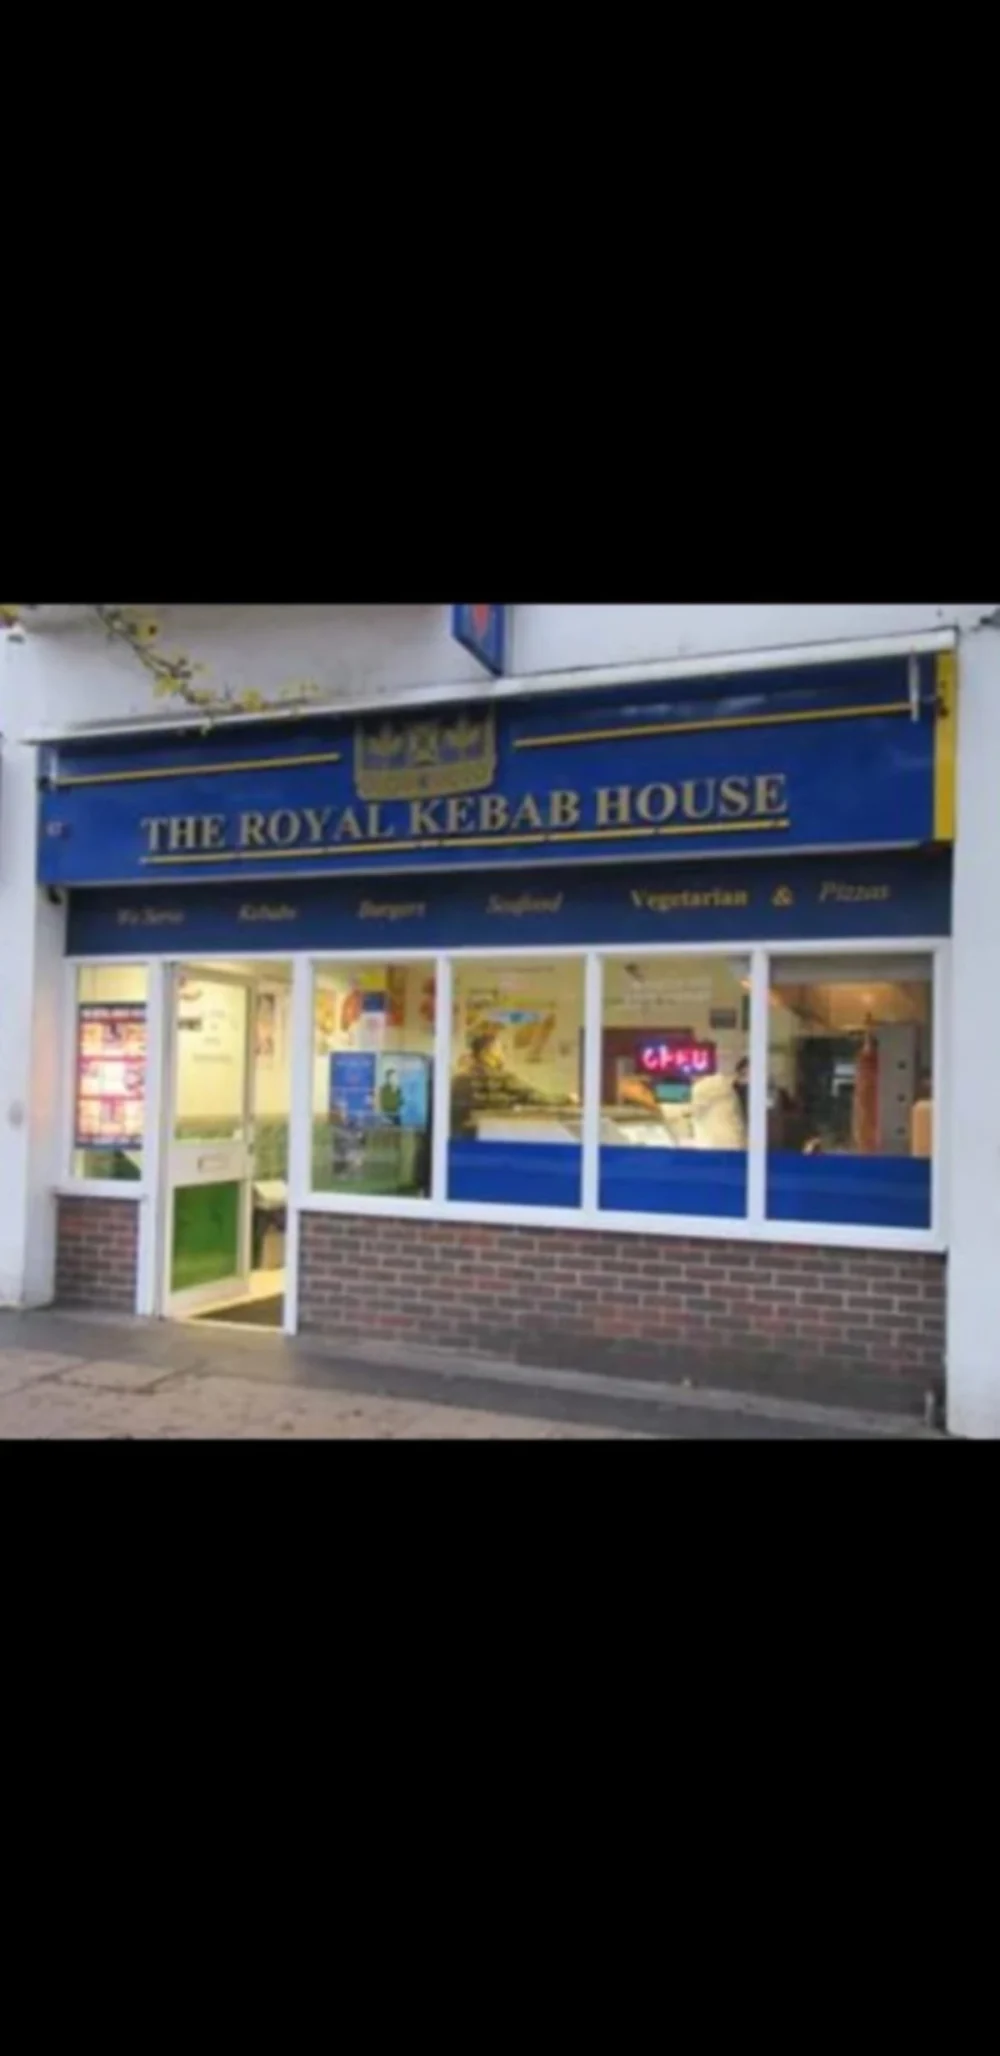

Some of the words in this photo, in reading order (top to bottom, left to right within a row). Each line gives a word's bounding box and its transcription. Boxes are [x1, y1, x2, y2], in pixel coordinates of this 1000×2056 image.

[140, 814, 226, 850] THE
[238, 803, 396, 846] ROYAL
[408, 790, 580, 836] KEBAB
[595, 774, 788, 825] HOUSE
[630, 889, 748, 914] Vegetarian
[772, 885, 793, 907] &
[818, 879, 892, 903] Pizzas
